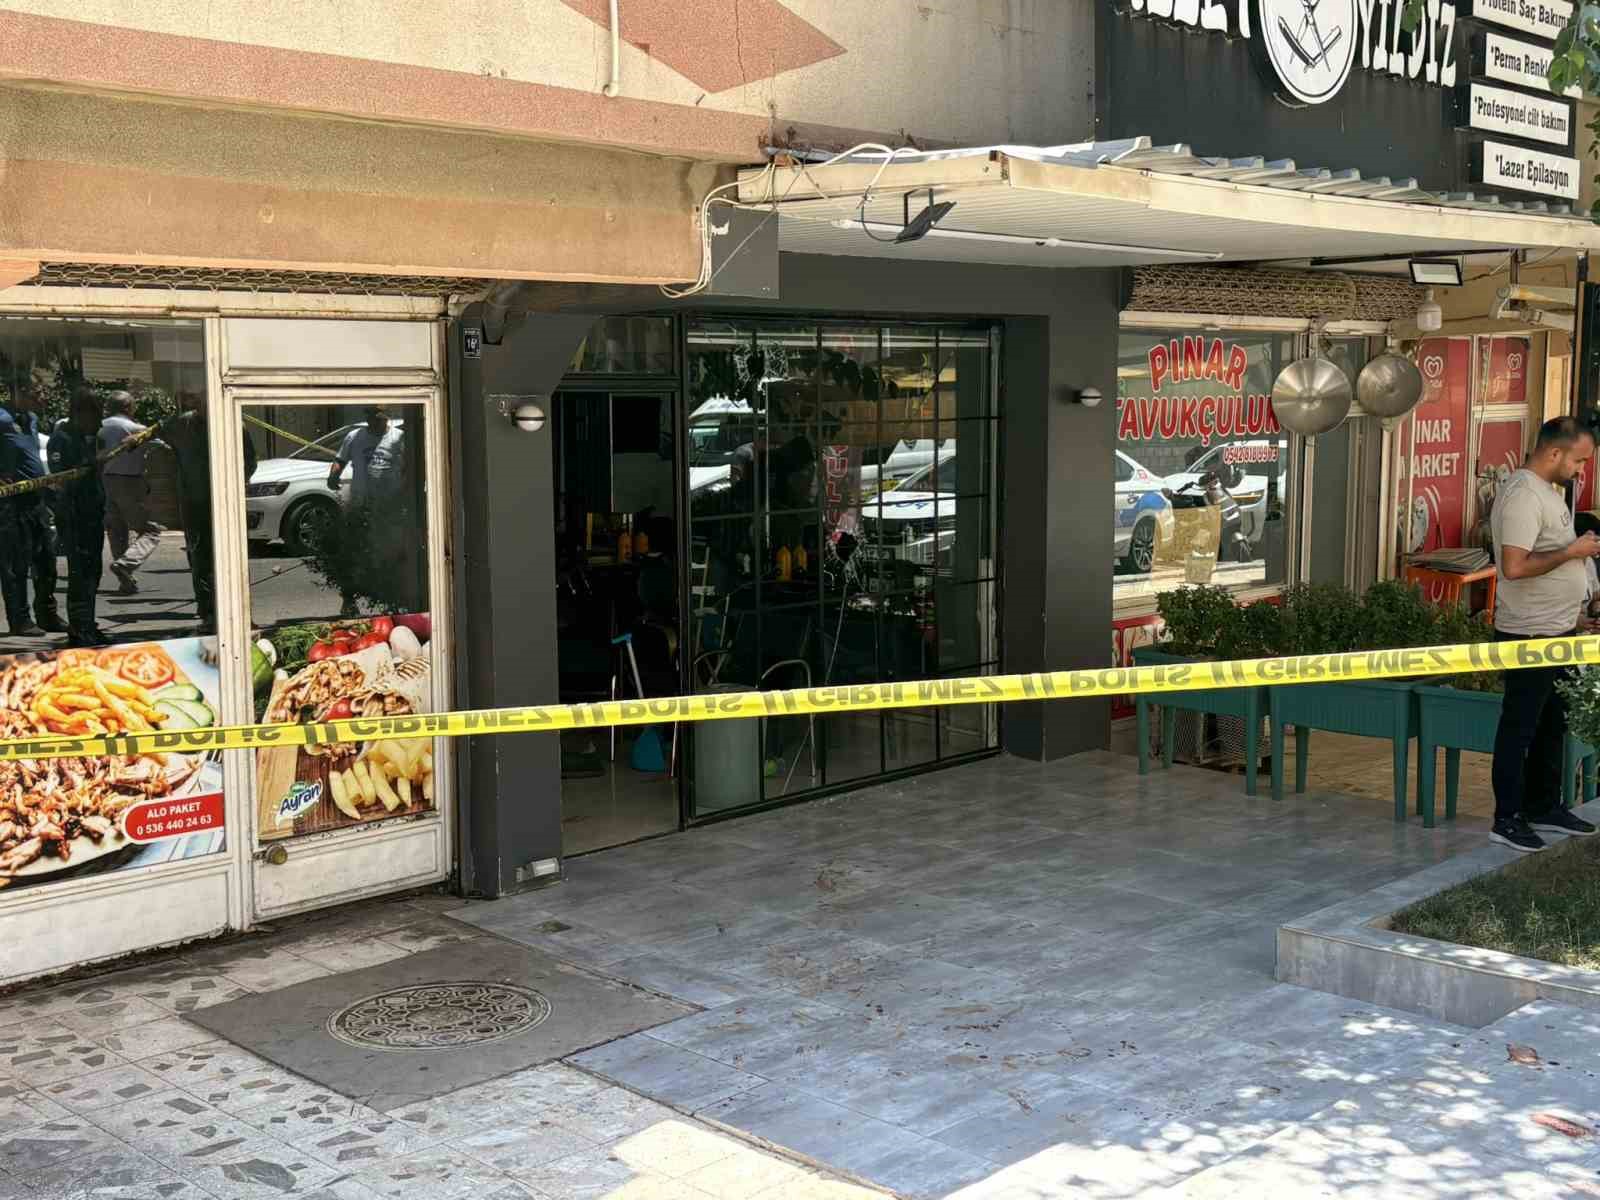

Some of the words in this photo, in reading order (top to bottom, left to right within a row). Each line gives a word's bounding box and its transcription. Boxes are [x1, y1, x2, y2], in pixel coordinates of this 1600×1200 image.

[1519, 0, 1537, 25] Saç
[1527, 159, 1569, 190] Epilasyon
[1148, 336, 1248, 393] PINAR
[1116, 395, 1281, 447] AVUKÇULUK
[1416, 419, 1451, 444] INAR
[146, 807, 168, 819] ALO
[169, 801, 201, 815] PAKET
[279, 783, 320, 816] Ayran
[136, 825, 144, 836] 0
[145, 822, 164, 834] 536
[166, 818, 184, 830] 440
[186, 816, 198, 828] 24
